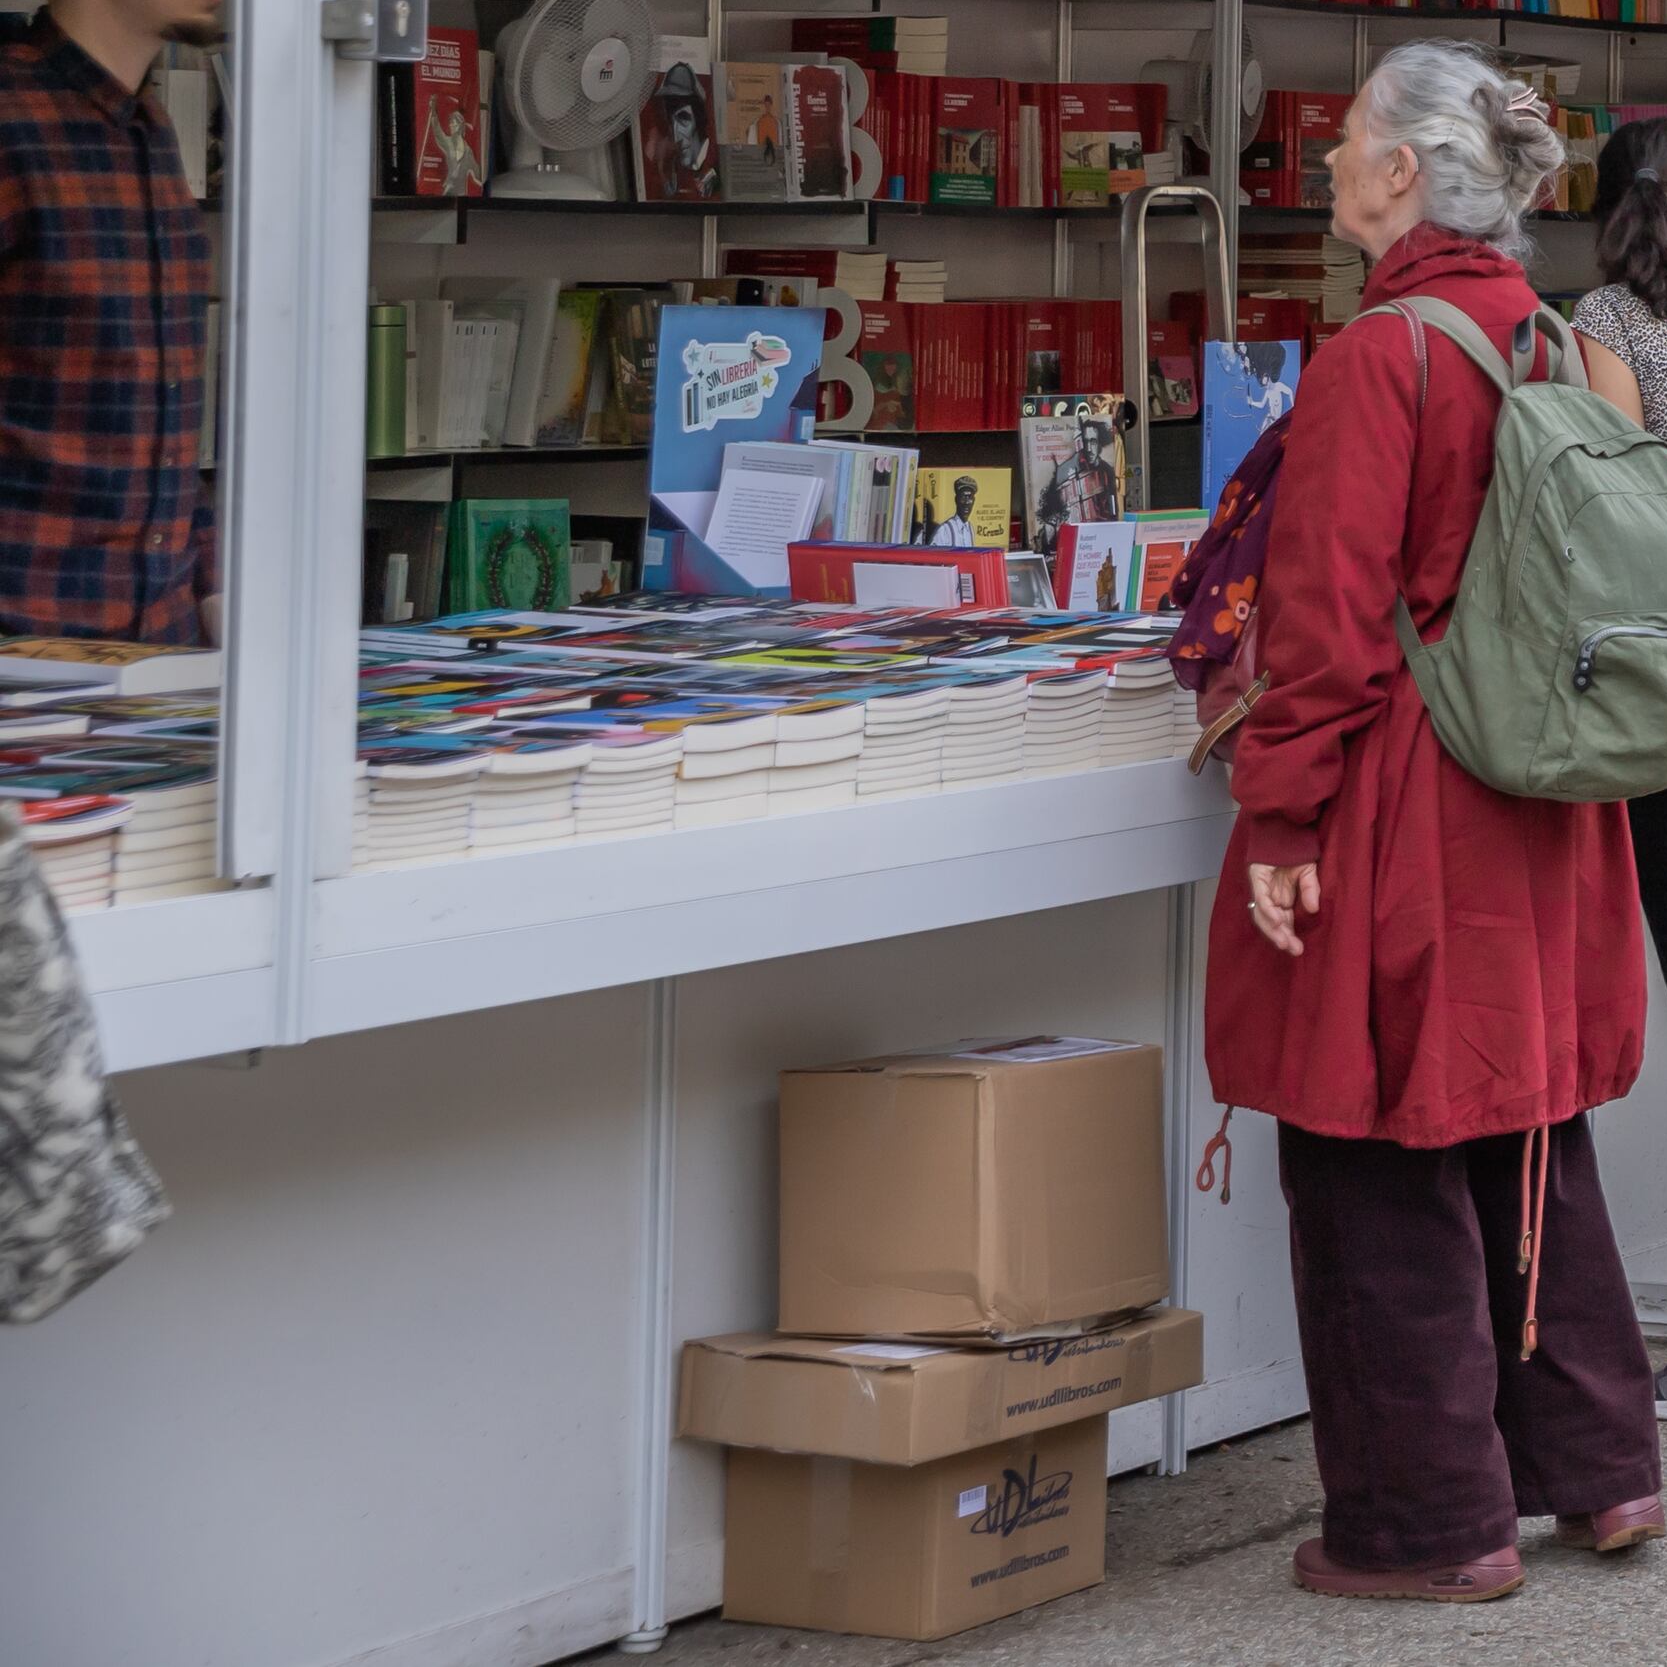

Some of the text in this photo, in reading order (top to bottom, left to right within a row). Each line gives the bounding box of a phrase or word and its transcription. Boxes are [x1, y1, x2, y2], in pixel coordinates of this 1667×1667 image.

[706, 368, 722, 392] SIN
[706, 395, 717, 411] NO
[717, 389, 731, 407] HAY
[1006, 1377, 1122, 1418] www.udllibros.com
